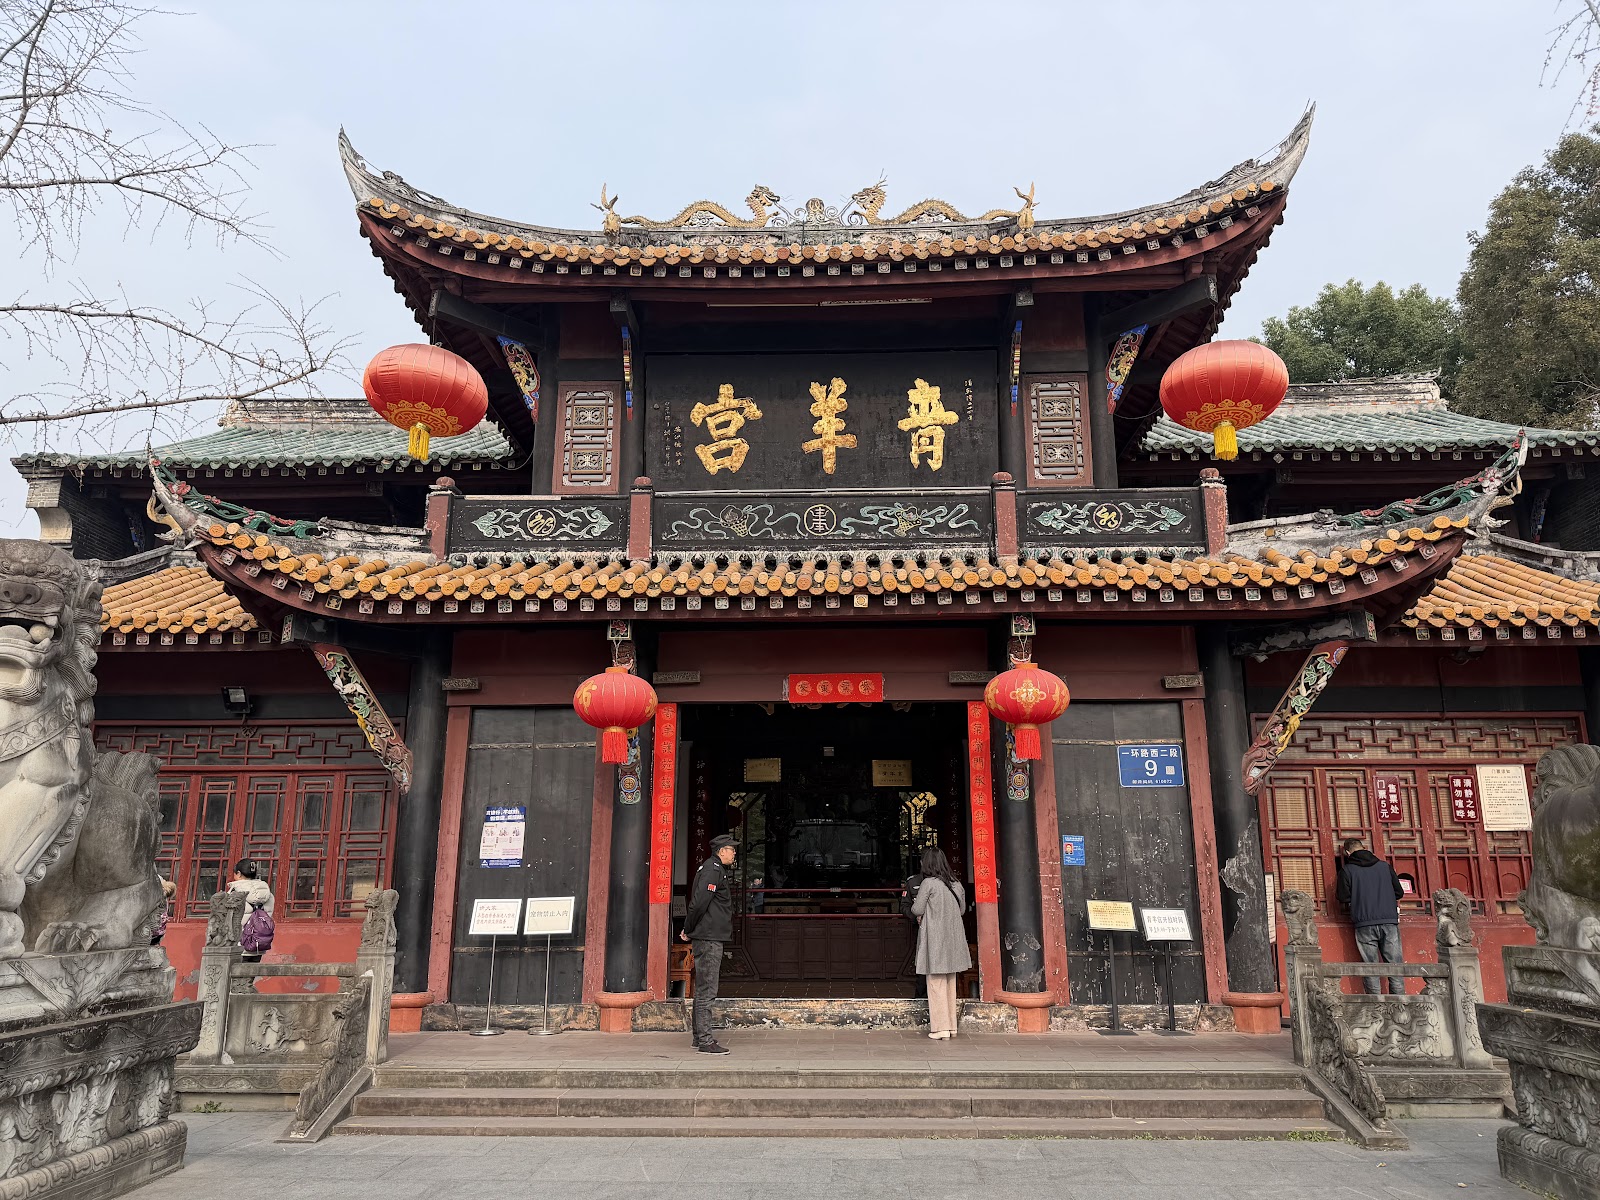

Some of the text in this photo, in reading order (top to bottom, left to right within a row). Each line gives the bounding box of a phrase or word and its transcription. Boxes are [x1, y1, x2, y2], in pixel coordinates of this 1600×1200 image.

[1122, 748, 1178, 758] 一环路西二段
[1144, 759, 1158, 777] 9
[1376, 779, 1390, 819] 门票5元
[1388, 784, 1400, 814] 售票处
[1453, 778, 1466, 819] 请勿喧哗
[1463, 778, 1476, 819] 清静之地
